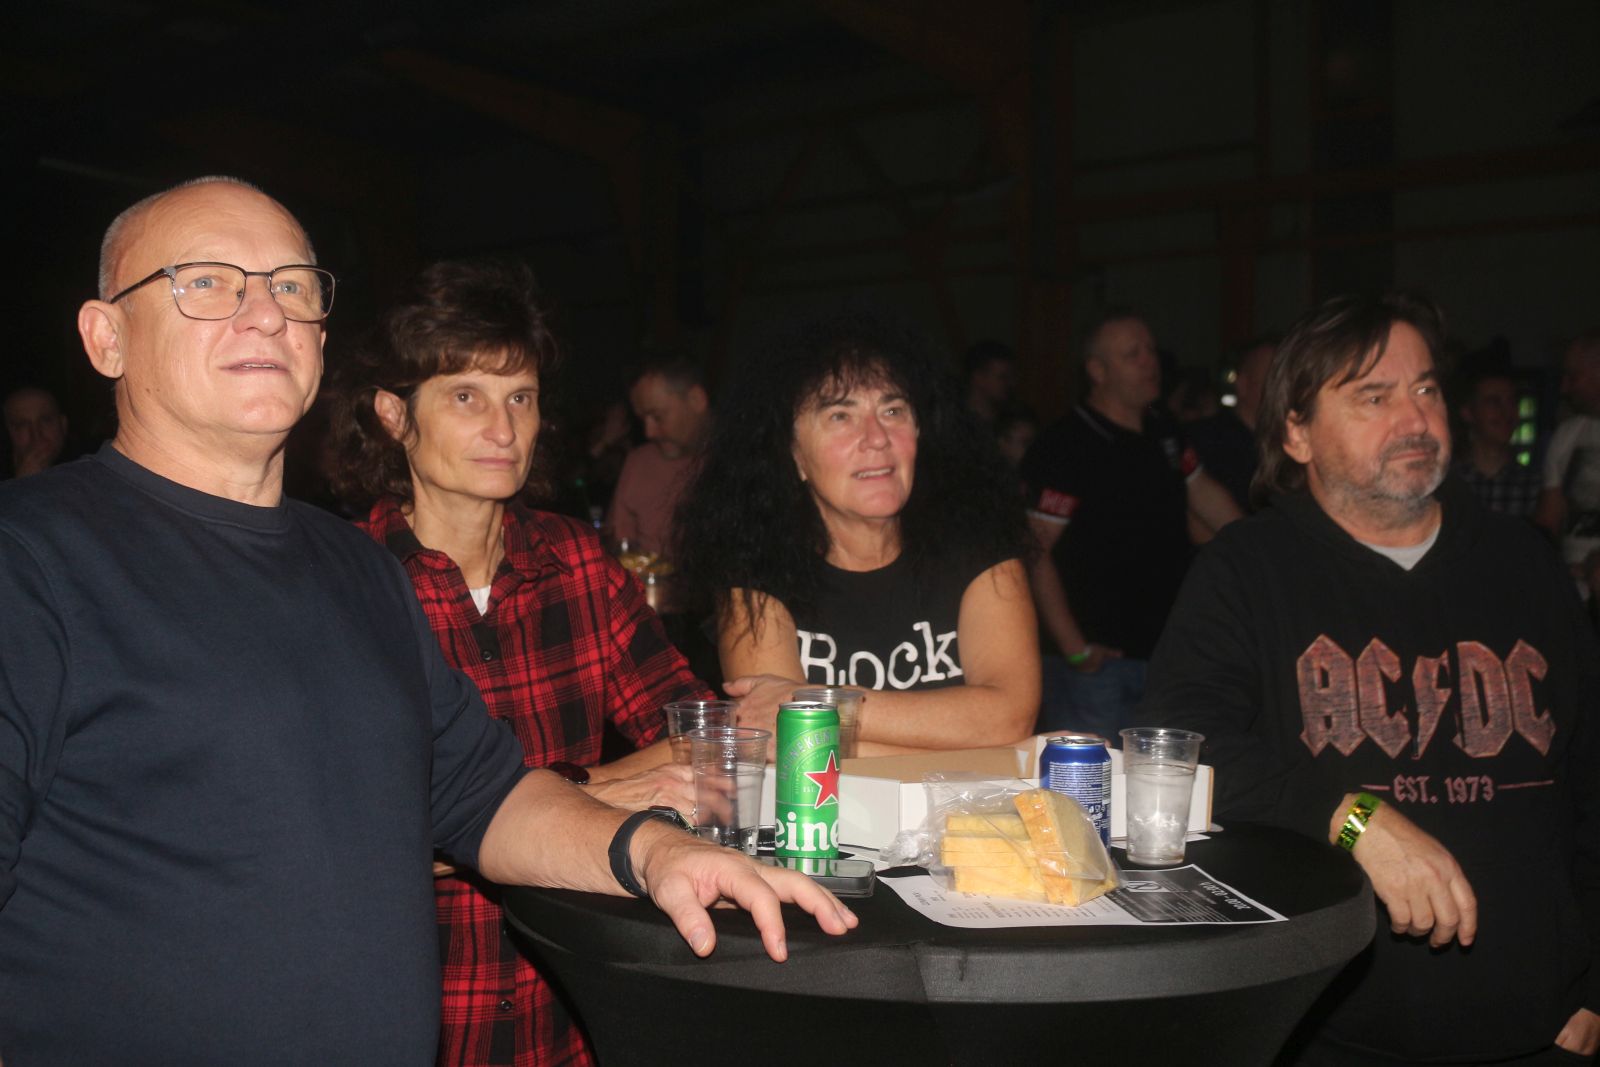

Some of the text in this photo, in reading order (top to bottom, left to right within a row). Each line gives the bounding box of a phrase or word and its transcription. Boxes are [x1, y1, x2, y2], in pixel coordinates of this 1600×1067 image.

[797, 621, 963, 690] Rock
[1394, 774, 1495, 804] EST. 1973
